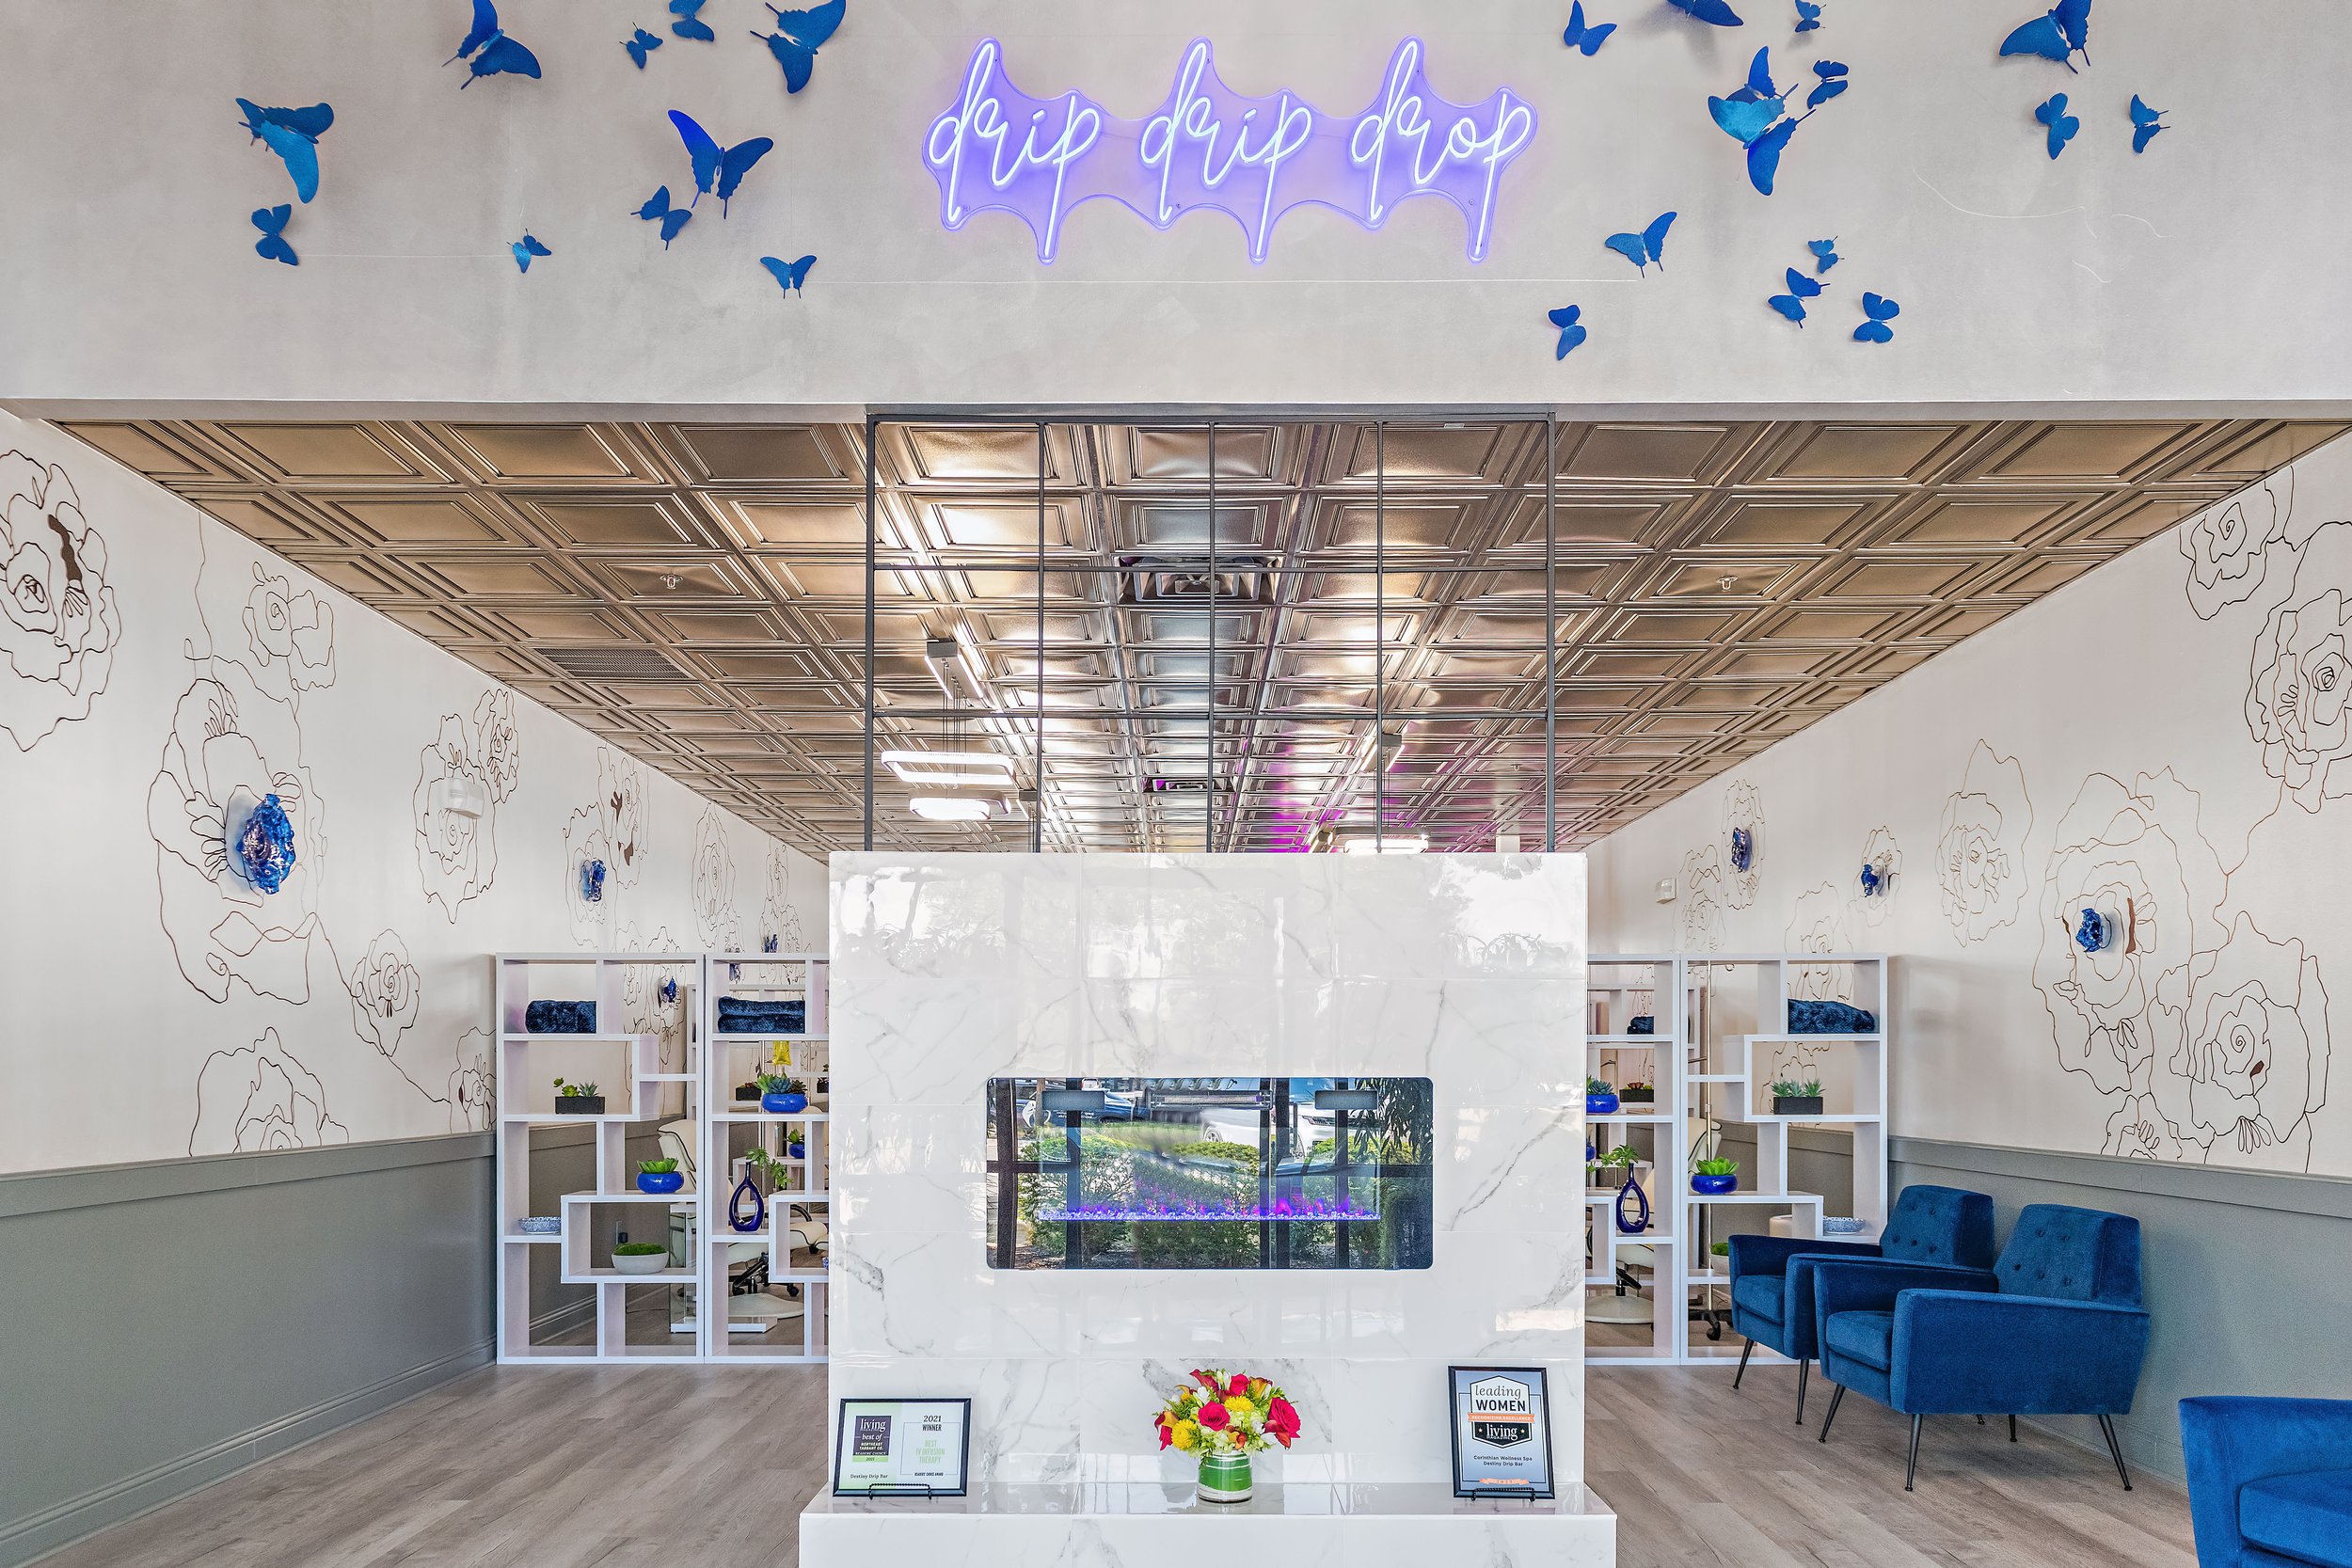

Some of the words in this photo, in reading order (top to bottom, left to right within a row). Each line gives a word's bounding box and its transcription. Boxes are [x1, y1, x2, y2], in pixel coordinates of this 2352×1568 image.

[929, 42, 1100, 257] drip
[1140, 42, 1311, 256] drip
[1351, 40, 1532, 255] drop
[1475, 1385, 1521, 1400] leading
[1475, 1400, 1526, 1411] WOMEN
[860, 1418, 886, 1433] living
[1486, 1423, 1518, 1440] living
